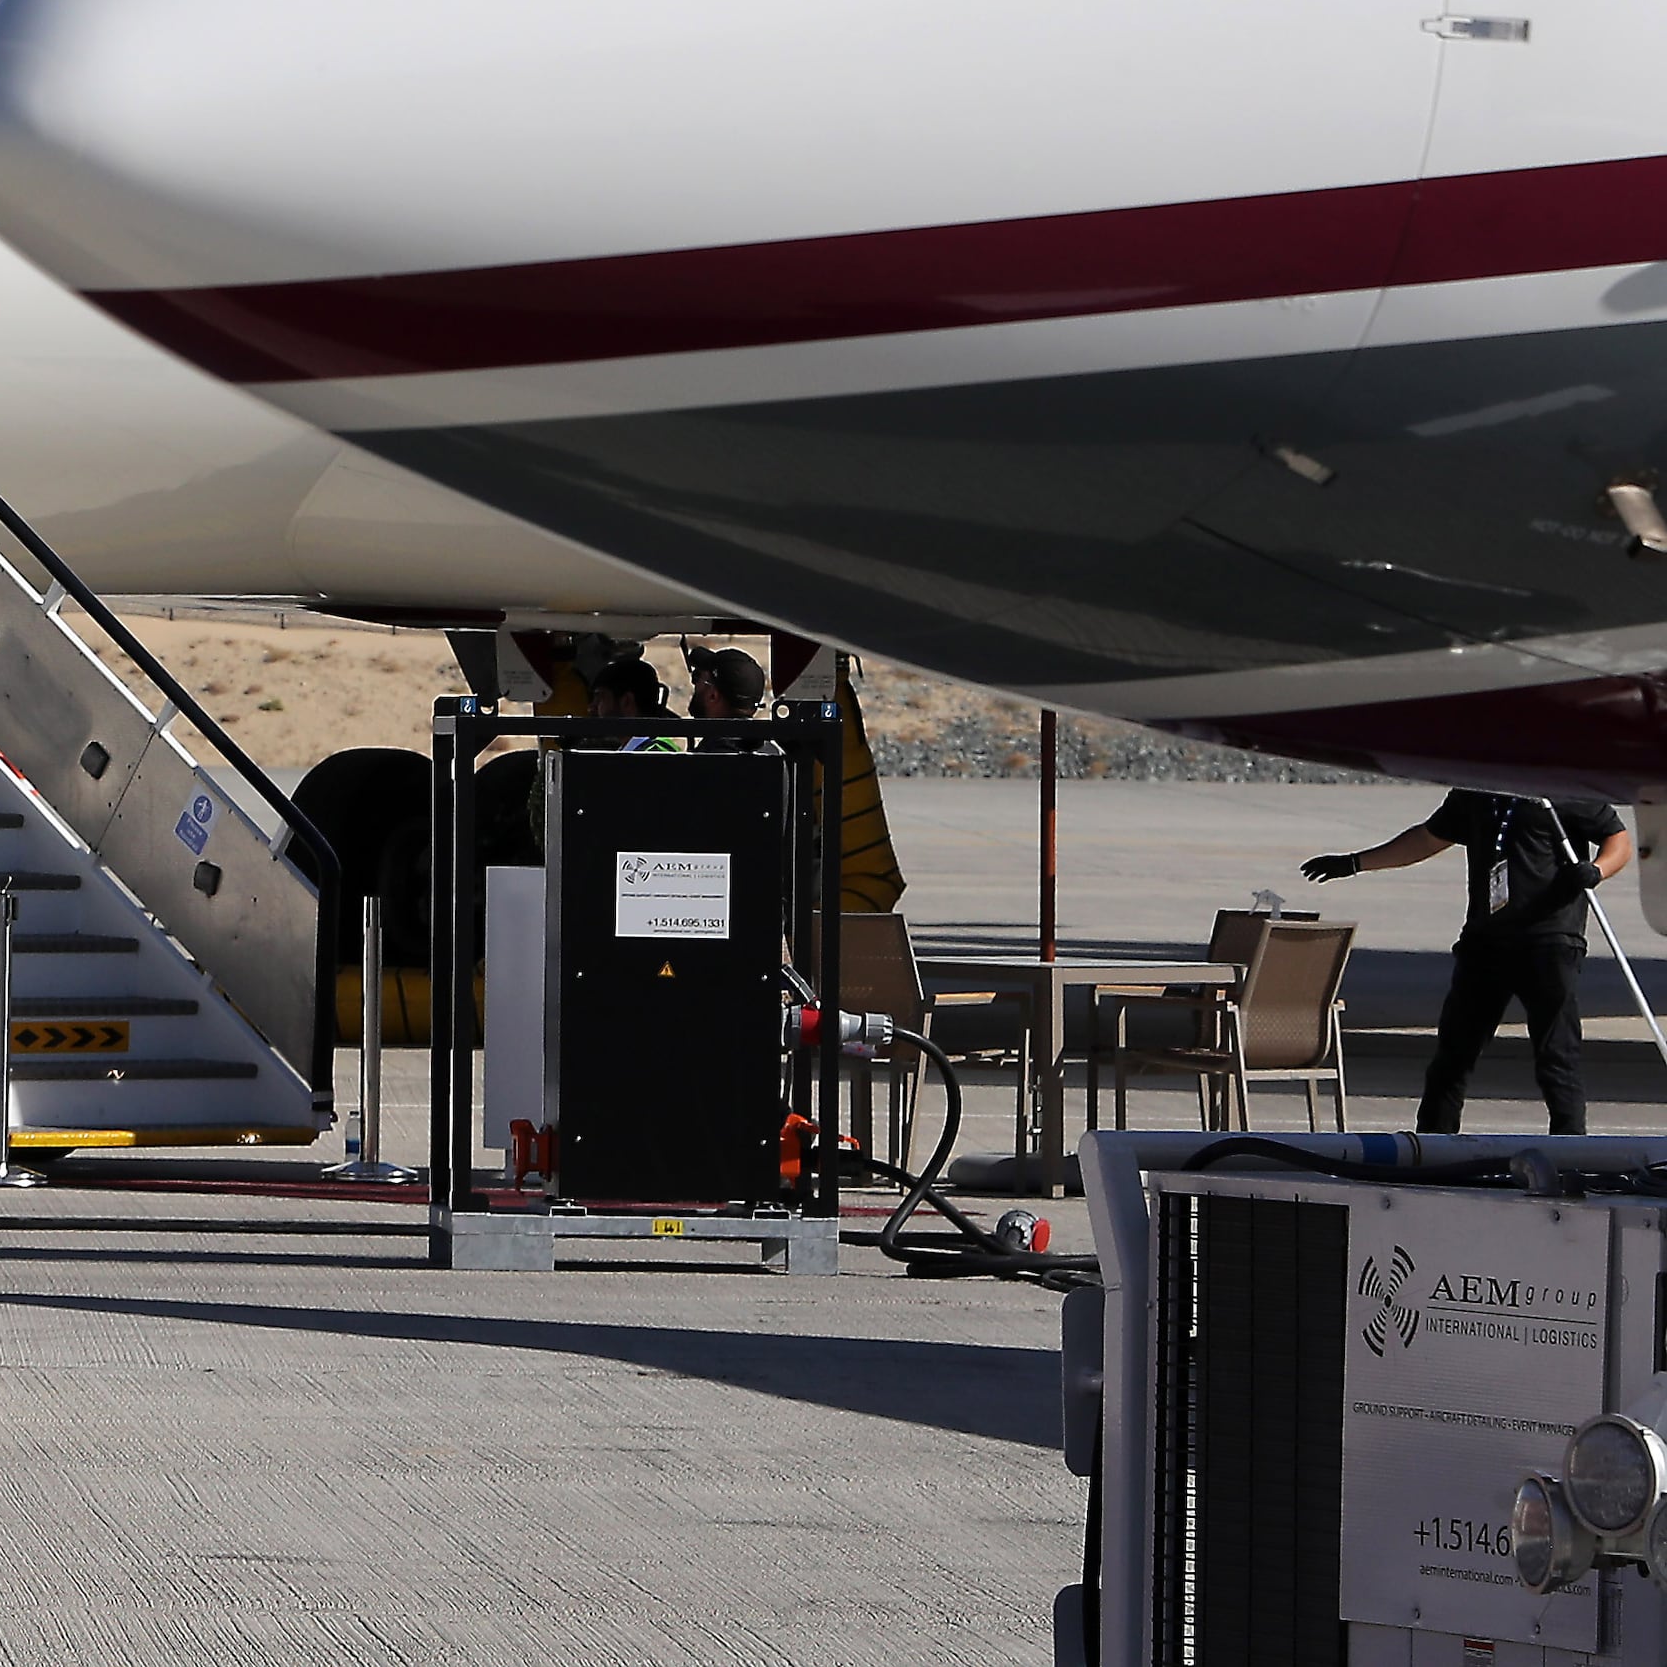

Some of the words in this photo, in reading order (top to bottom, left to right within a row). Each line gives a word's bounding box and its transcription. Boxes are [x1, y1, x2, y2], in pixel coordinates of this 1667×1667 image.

[653, 863, 692, 871] AEM
[1428, 1274, 1521, 1308] AEM
[1525, 1285, 1597, 1310] group
[1426, 1317, 1520, 1342] INTERNATIONAL
[1532, 1328, 1598, 1350] LOGISTICS
[1353, 1401, 1388, 1417] GROUND
[1388, 1405, 1424, 1420] SUPPORT
[1512, 1419, 1538, 1434] EVENT
[1414, 1516, 1516, 1558] +1.514.6
[1419, 1562, 1514, 1586] aeminternational.com
